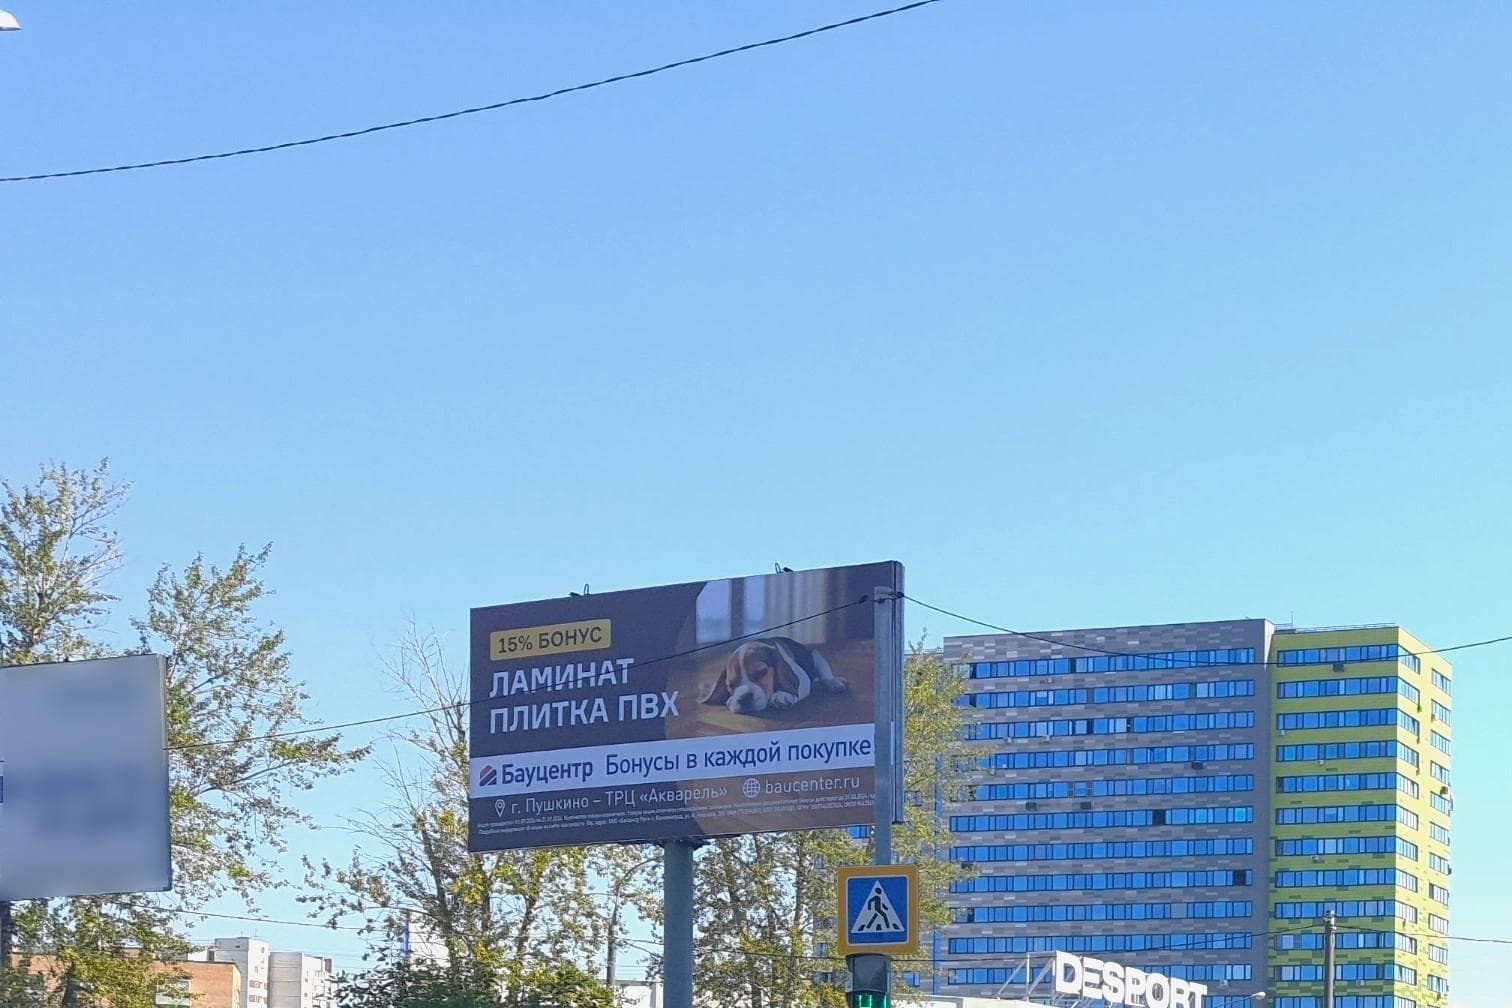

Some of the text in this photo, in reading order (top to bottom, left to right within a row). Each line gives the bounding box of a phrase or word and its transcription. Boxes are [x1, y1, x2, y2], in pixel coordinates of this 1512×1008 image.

[498, 626, 602, 654] 15% БОНУС
[489, 658, 635, 698] ЛАМИНАТ
[490, 690, 680, 734] ПЛИТКА ПВХ
[501, 739, 872, 787] Бауцентр Бонусы в каждой покупке
[511, 803, 521, 815] г.
[526, 796, 589, 816] Пушкино
[605, 790, 636, 807] ТРЦ
[639, 786, 728, 804] «Акварель»
[765, 776, 860, 794] baucenter.ru
